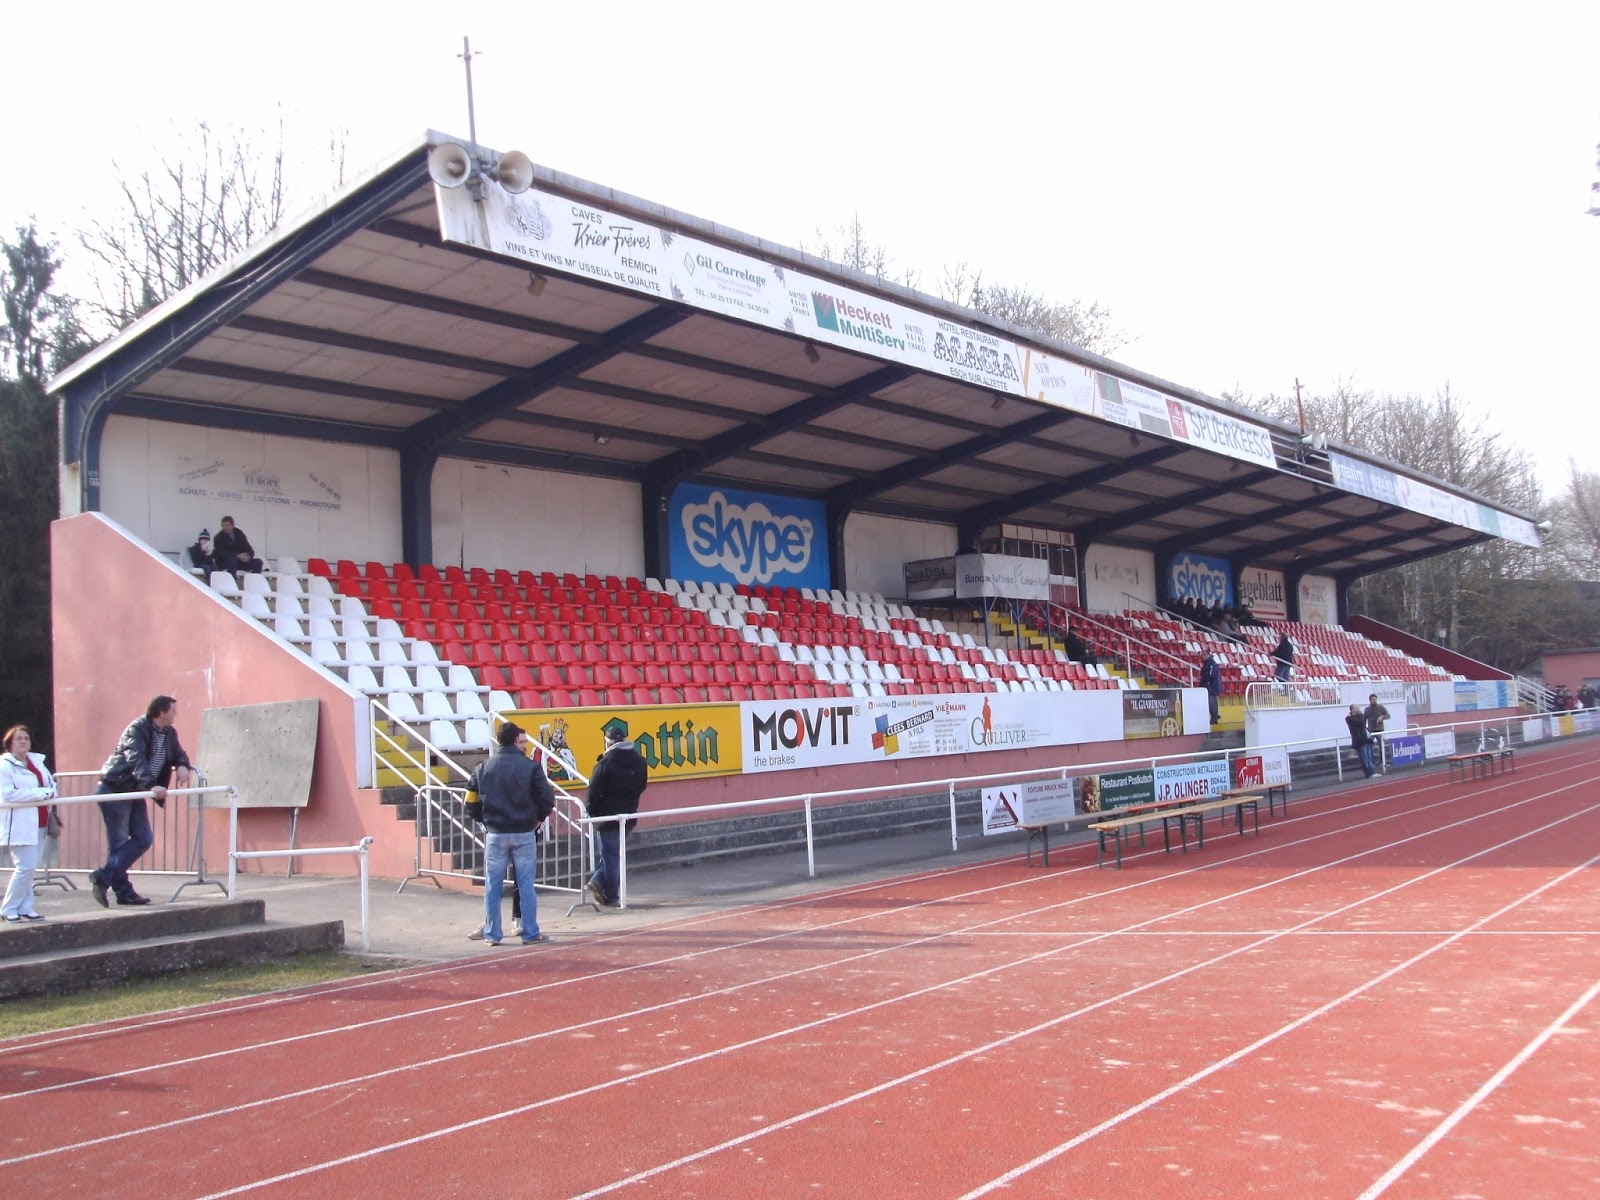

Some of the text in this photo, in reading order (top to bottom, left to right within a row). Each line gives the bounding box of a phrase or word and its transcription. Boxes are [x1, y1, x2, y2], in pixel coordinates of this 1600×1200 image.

[572, 206, 602, 224] CAVES
[572, 222, 610, 249] Krier
[504, 241, 527, 255] VINS
[528, 247, 540, 259] ET
[542, 251, 563, 266] VINS
[614, 271, 626, 282] DE
[627, 274, 661, 292] QUALITE
[621, 256, 658, 275] REMICH
[696, 254, 767, 287] Gil Carrelage
[836, 298, 892, 330] Heckett
[840, 318, 906, 351] MultiServ
[938, 320, 960, 335] HOTEL
[960, 328, 1000, 348] RESTAURANT
[933, 332, 1019, 382] ACACIA
[950, 366, 968, 380] ESCH
[982, 375, 1009, 391] ALZETTE
[1040, 376, 1067, 388] OPTICS
[1190, 412, 1272, 460] SPUERKEESS
[245, 476, 280, 488] EUROPE
[178, 488, 207, 497] ACHATS
[217, 491, 244, 500] VENTES
[252, 496, 290, 505] LOCATIONS
[300, 500, 341, 510] PROMOTIONS
[692, 500, 805, 575] skype
[1176, 562, 1224, 601] skype
[1239, 572, 1283, 609] ageblatt
[936, 702, 966, 714] VIESSMANN
[886, 722, 905, 736] CLEES
[906, 710, 934, 729] BERNARD
[913, 726, 924, 737] FILS
[971, 716, 1027, 747] GULLIVER
[601, 716, 719, 770] attin
[754, 754, 796, 767] the brakes
[1156, 763, 1227, 780] CONSTRUCTIONS METALLIQUES
[1027, 785, 1044, 794] TOITURE
[1044, 784, 1056, 792] BRUCK
[1100, 776, 1128, 789] Restaurant
[1158, 784, 1172, 802] J.P.
[1174, 778, 1210, 798] OLINGER
